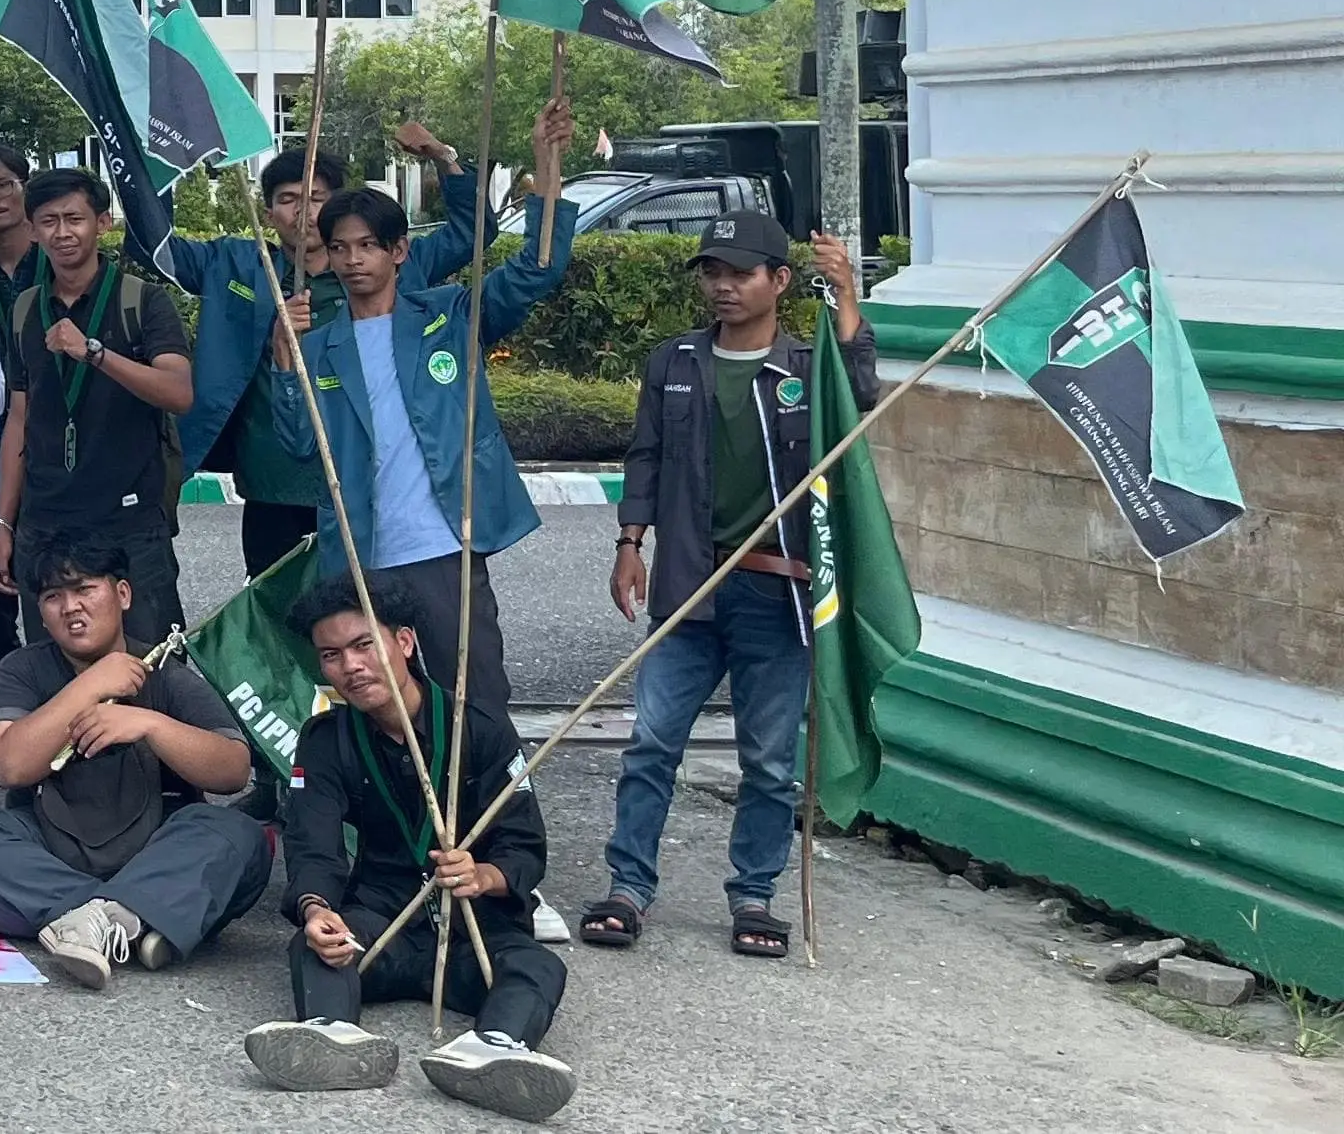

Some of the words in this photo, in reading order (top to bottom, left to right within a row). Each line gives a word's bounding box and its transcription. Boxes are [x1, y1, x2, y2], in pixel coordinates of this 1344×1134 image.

[1065, 381, 1114, 438] HIMPUNAN
[1149, 498, 1177, 536] ISLAM
[1068, 405, 1104, 450] CABANG
[1100, 447, 1136, 501] BATANG
[1125, 490, 1151, 522] HARI
[226, 680, 263, 722] PC
[253, 710, 300, 766] IPN
